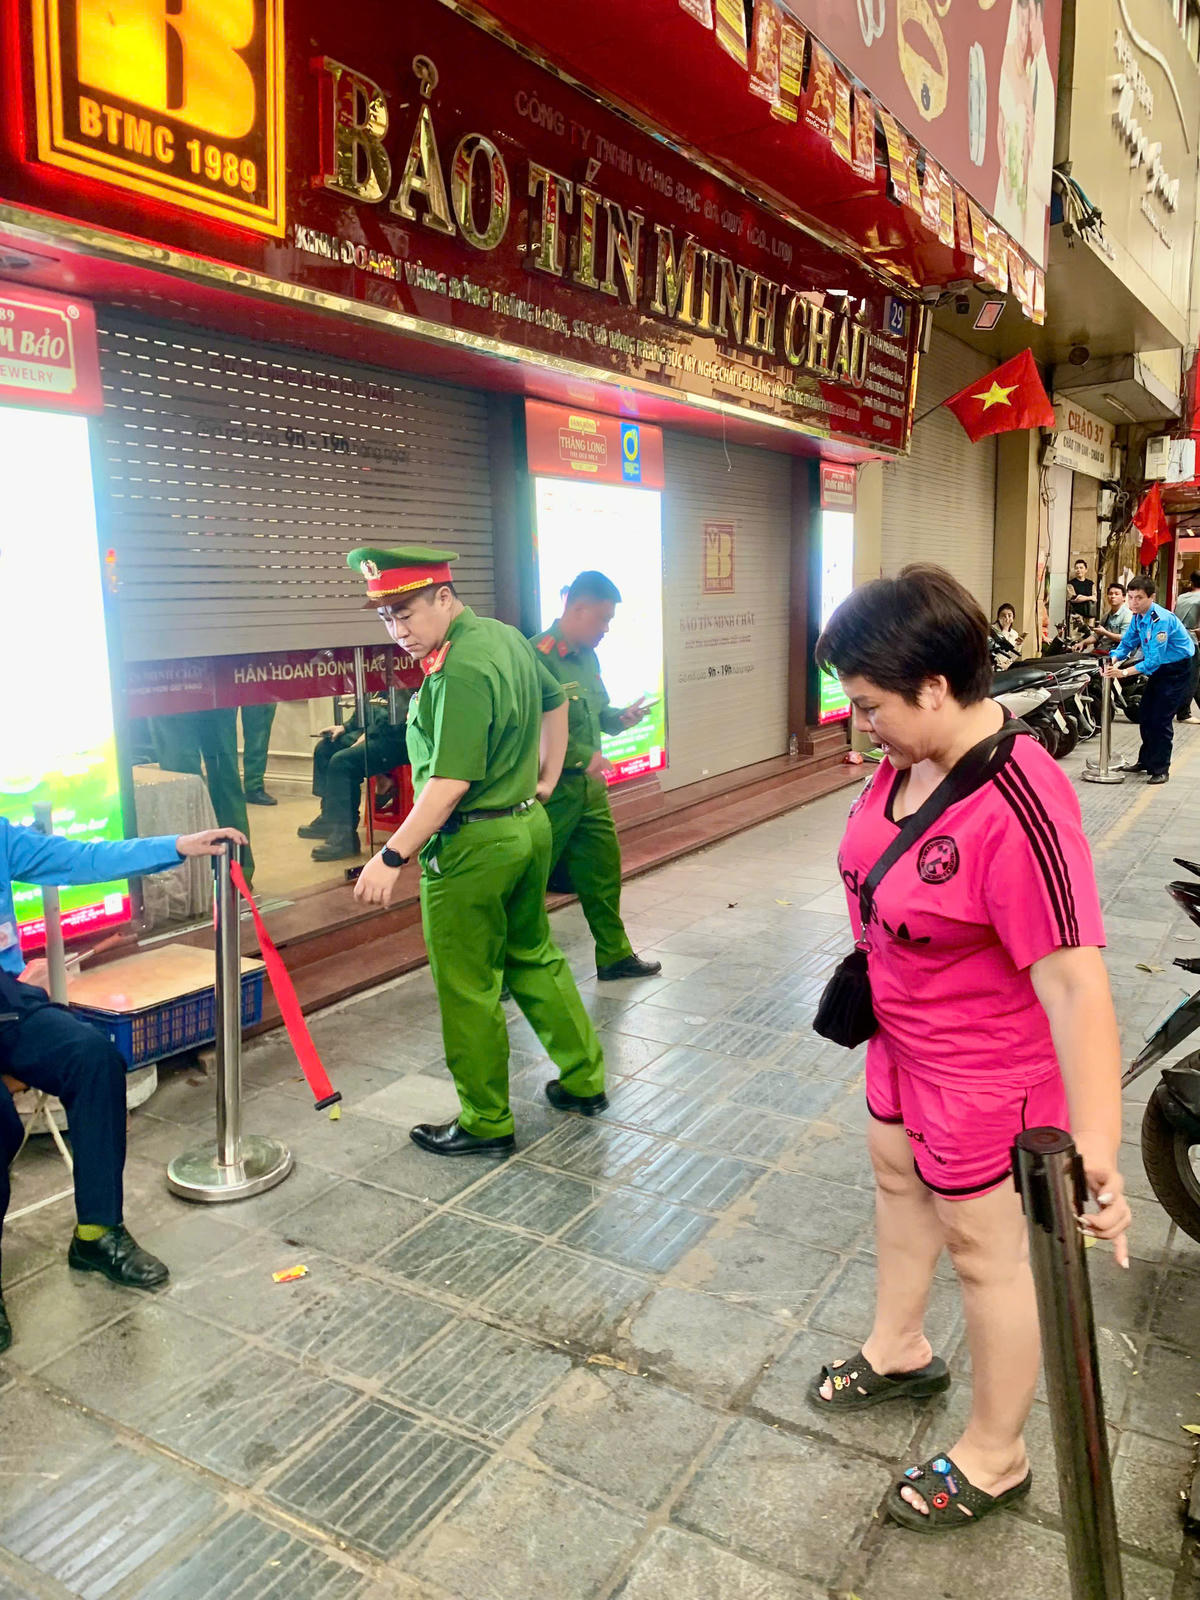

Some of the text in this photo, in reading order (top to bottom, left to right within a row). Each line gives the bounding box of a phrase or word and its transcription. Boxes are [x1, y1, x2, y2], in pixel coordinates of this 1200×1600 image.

[79, 96, 257, 193] BTMC 1989
[514, 90, 565, 136] CÔNG
[567, 120, 591, 150] TY
[595, 134, 633, 177] TNHH
[636, 158, 673, 198] VÀNG
[310, 55, 869, 388] BẢO TÍN MINH CHÂU
[295, 223, 339, 261] KINH
[340, 239, 402, 281] DOANH
[404, 259, 446, 295] VÀNG
[449, 274, 490, 308] RỒNG
[492, 291, 535, 323] THĂNG
[636, 339, 667, 365] TRANG
[667, 346, 683, 368] SỨC
[684, 351, 697, 374] MỸ
[891, 302, 904, 329] 29
[20, 327, 65, 359] BẢO
[560, 435, 606, 454] THĂNG LONG
[1068, 411, 1104, 445] CHÁO 37
[234, 662, 268, 684] HÂN
[271, 661, 314, 681] HOAN
